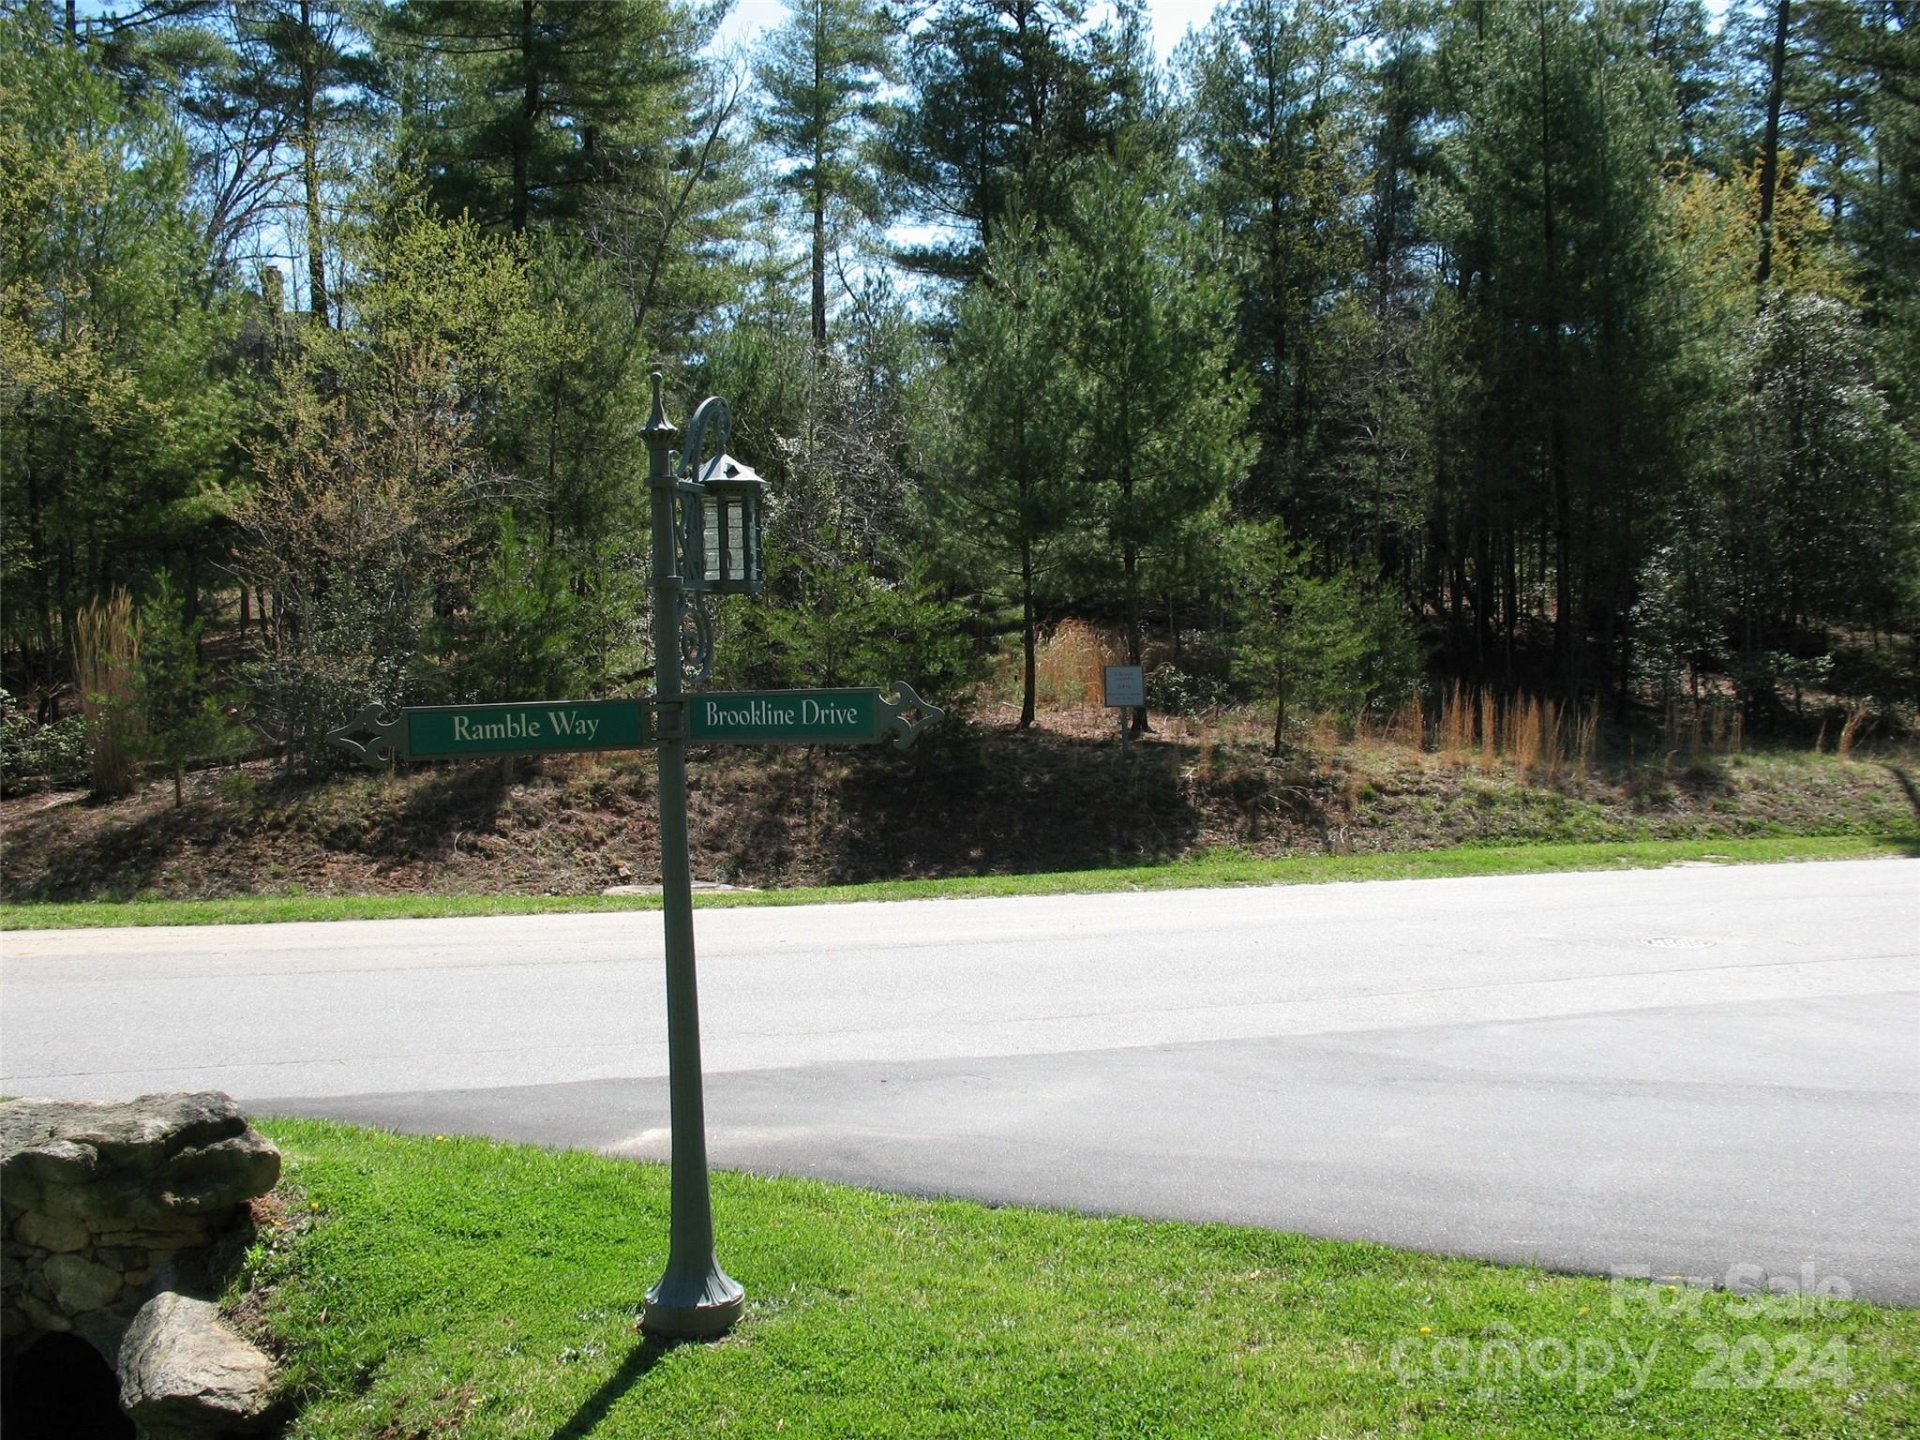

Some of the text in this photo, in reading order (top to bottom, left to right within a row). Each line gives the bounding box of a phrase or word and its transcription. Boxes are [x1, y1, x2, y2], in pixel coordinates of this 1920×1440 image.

[453, 711, 600, 741] Ramble Way
[706, 699, 858, 726] Brookline Drive
